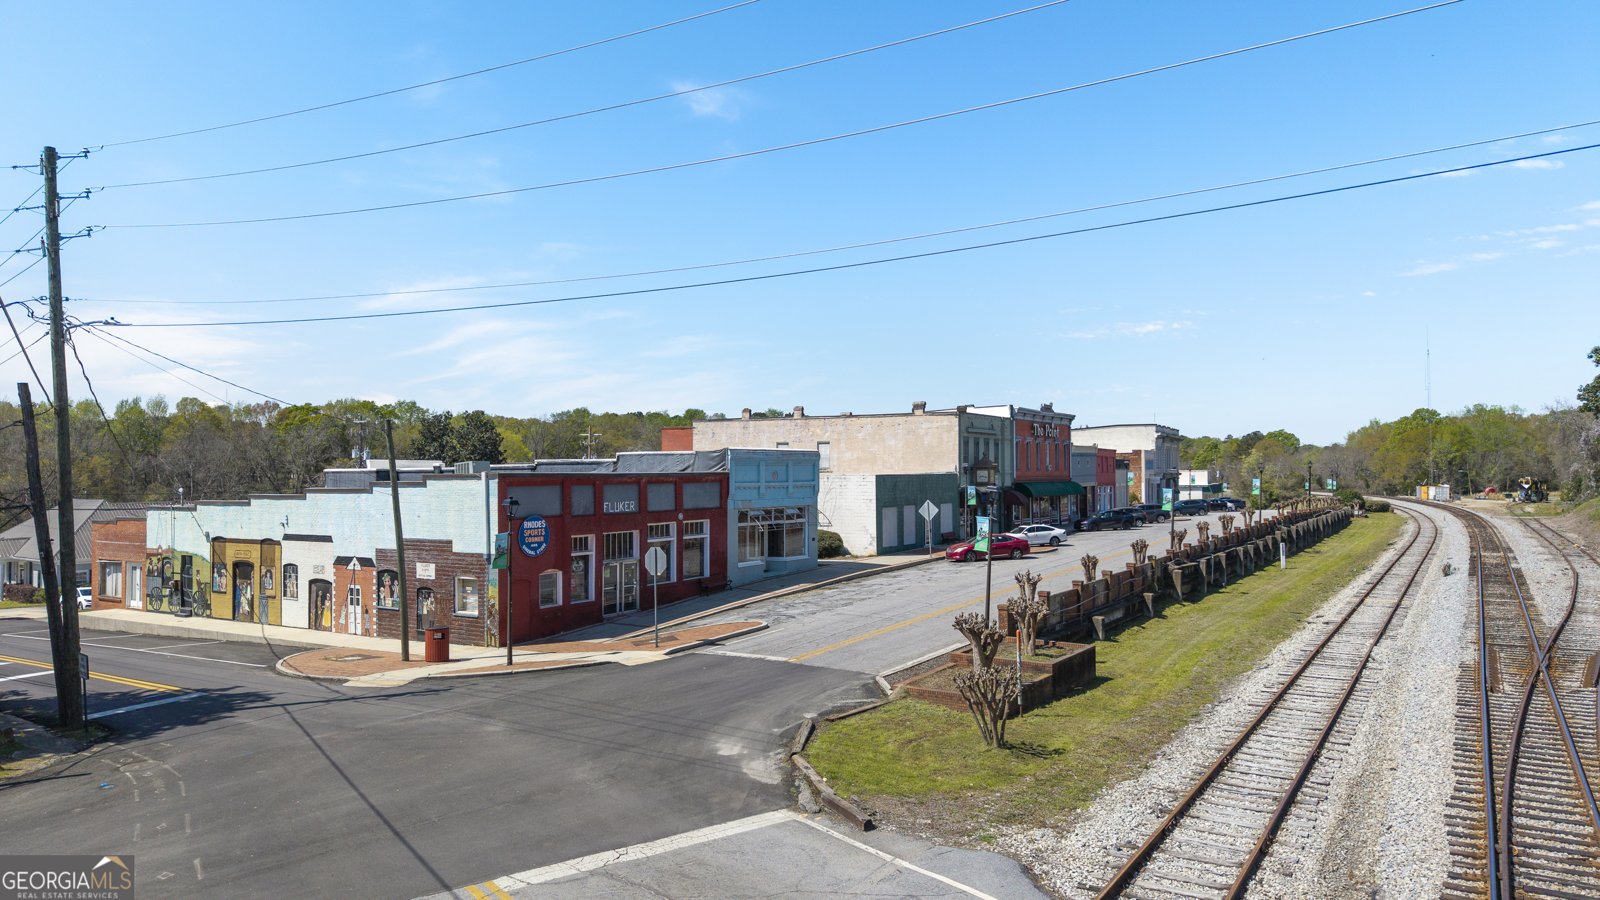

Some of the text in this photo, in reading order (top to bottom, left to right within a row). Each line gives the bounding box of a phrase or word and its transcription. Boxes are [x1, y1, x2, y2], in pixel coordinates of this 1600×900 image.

[1033, 422, 1059, 437] The Point
[603, 501, 635, 512] FLUKER
[523, 520, 546, 529] RHODES
[523, 529, 545, 537] SPORTS
